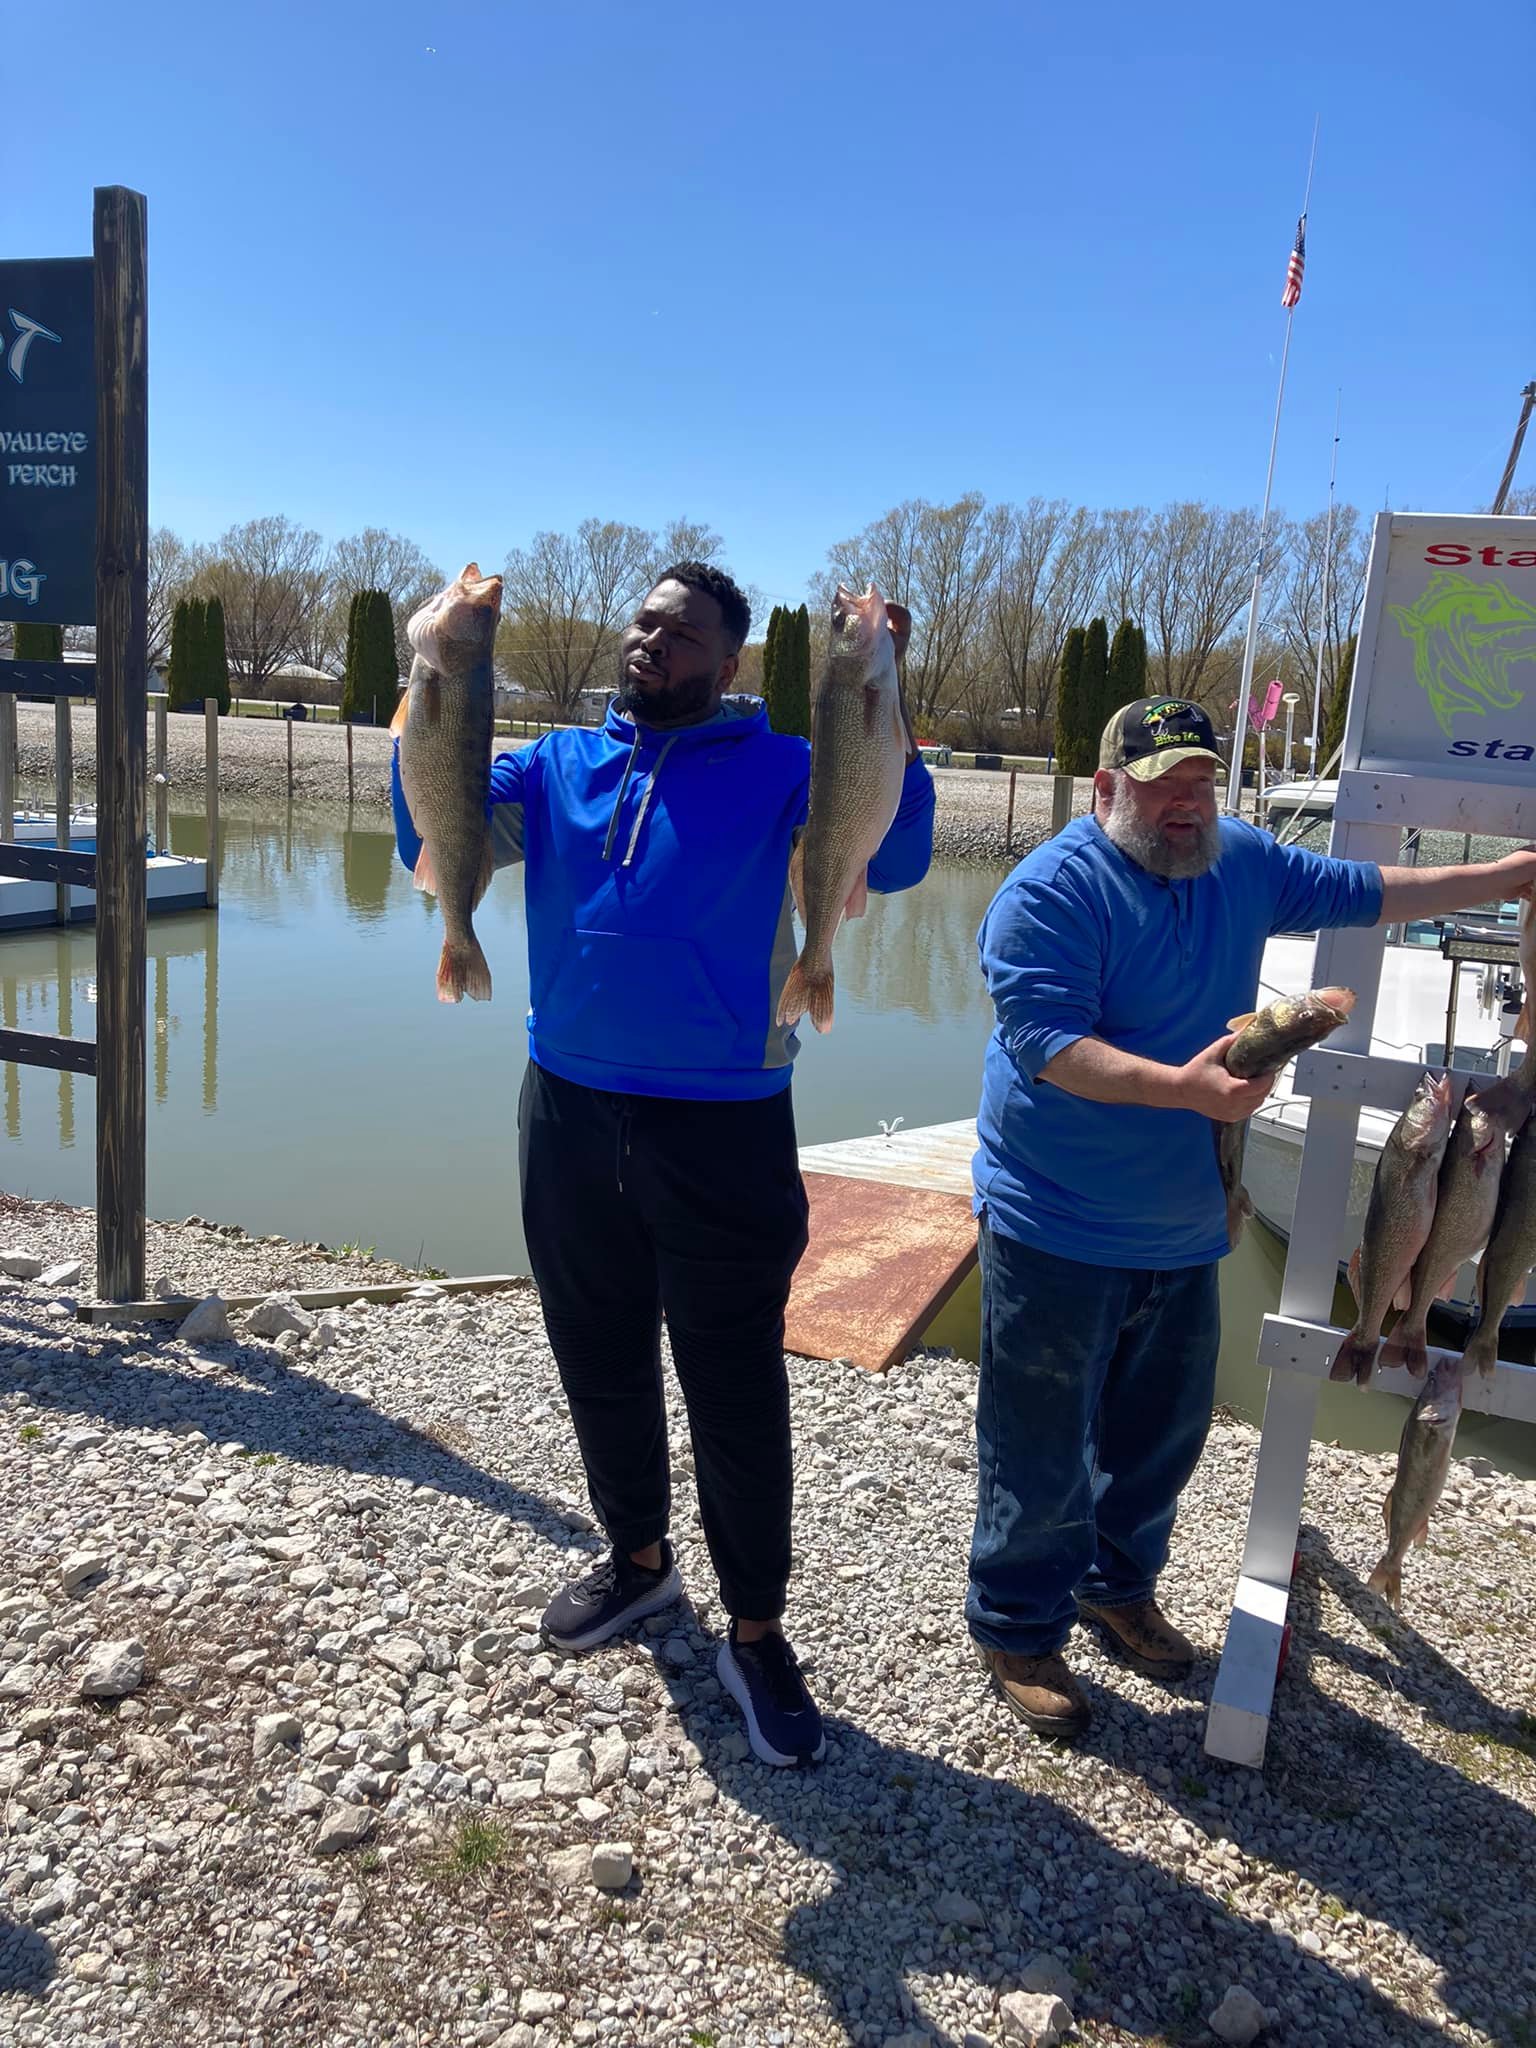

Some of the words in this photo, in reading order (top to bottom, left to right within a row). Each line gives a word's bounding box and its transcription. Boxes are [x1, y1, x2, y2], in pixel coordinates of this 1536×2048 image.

[0, 308, 62, 384] T
[7, 463, 78, 488] PERCH
[1424, 543, 1536, 567] Sta
[1153, 734, 1182, 746] Bite
[1182, 732, 1201, 742] Me
[1447, 739, 1535, 761] sta
